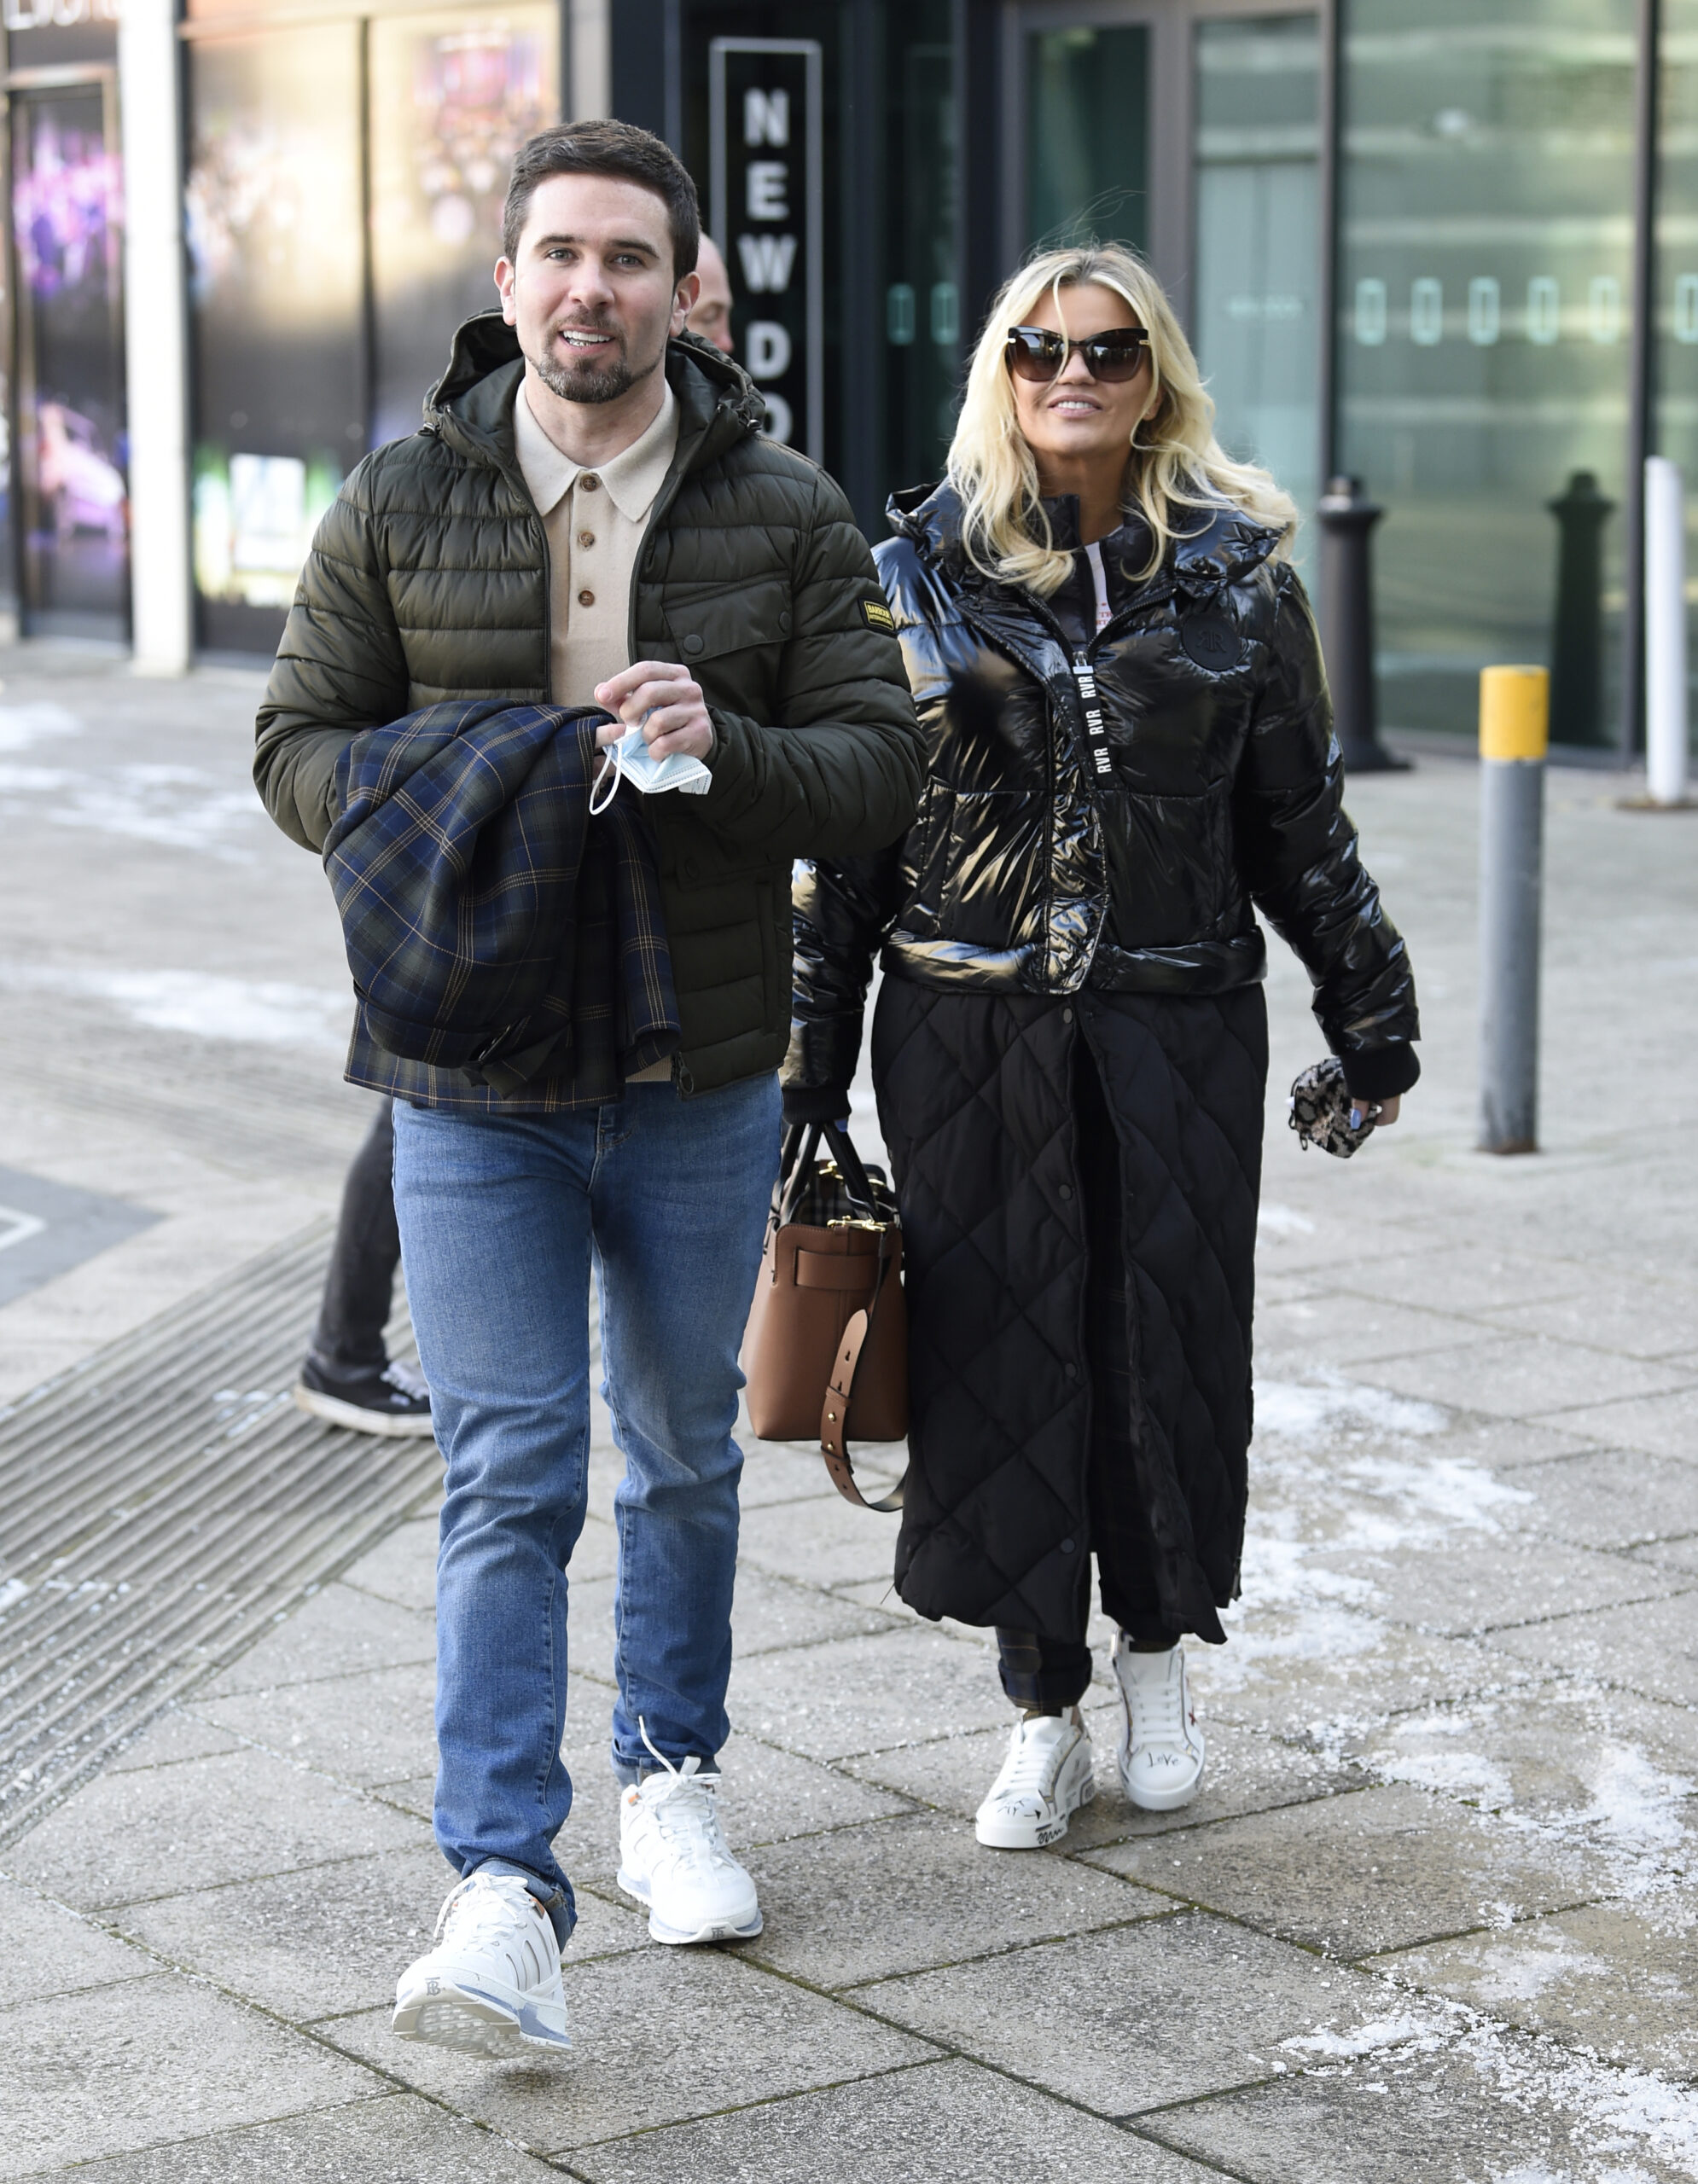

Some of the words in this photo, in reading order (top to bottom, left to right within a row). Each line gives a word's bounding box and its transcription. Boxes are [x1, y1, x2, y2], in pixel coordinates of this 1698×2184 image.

[1078, 675, 1096, 699] RVR
[1085, 709, 1105, 735] RVR
[1093, 747, 1113, 774] RVR
